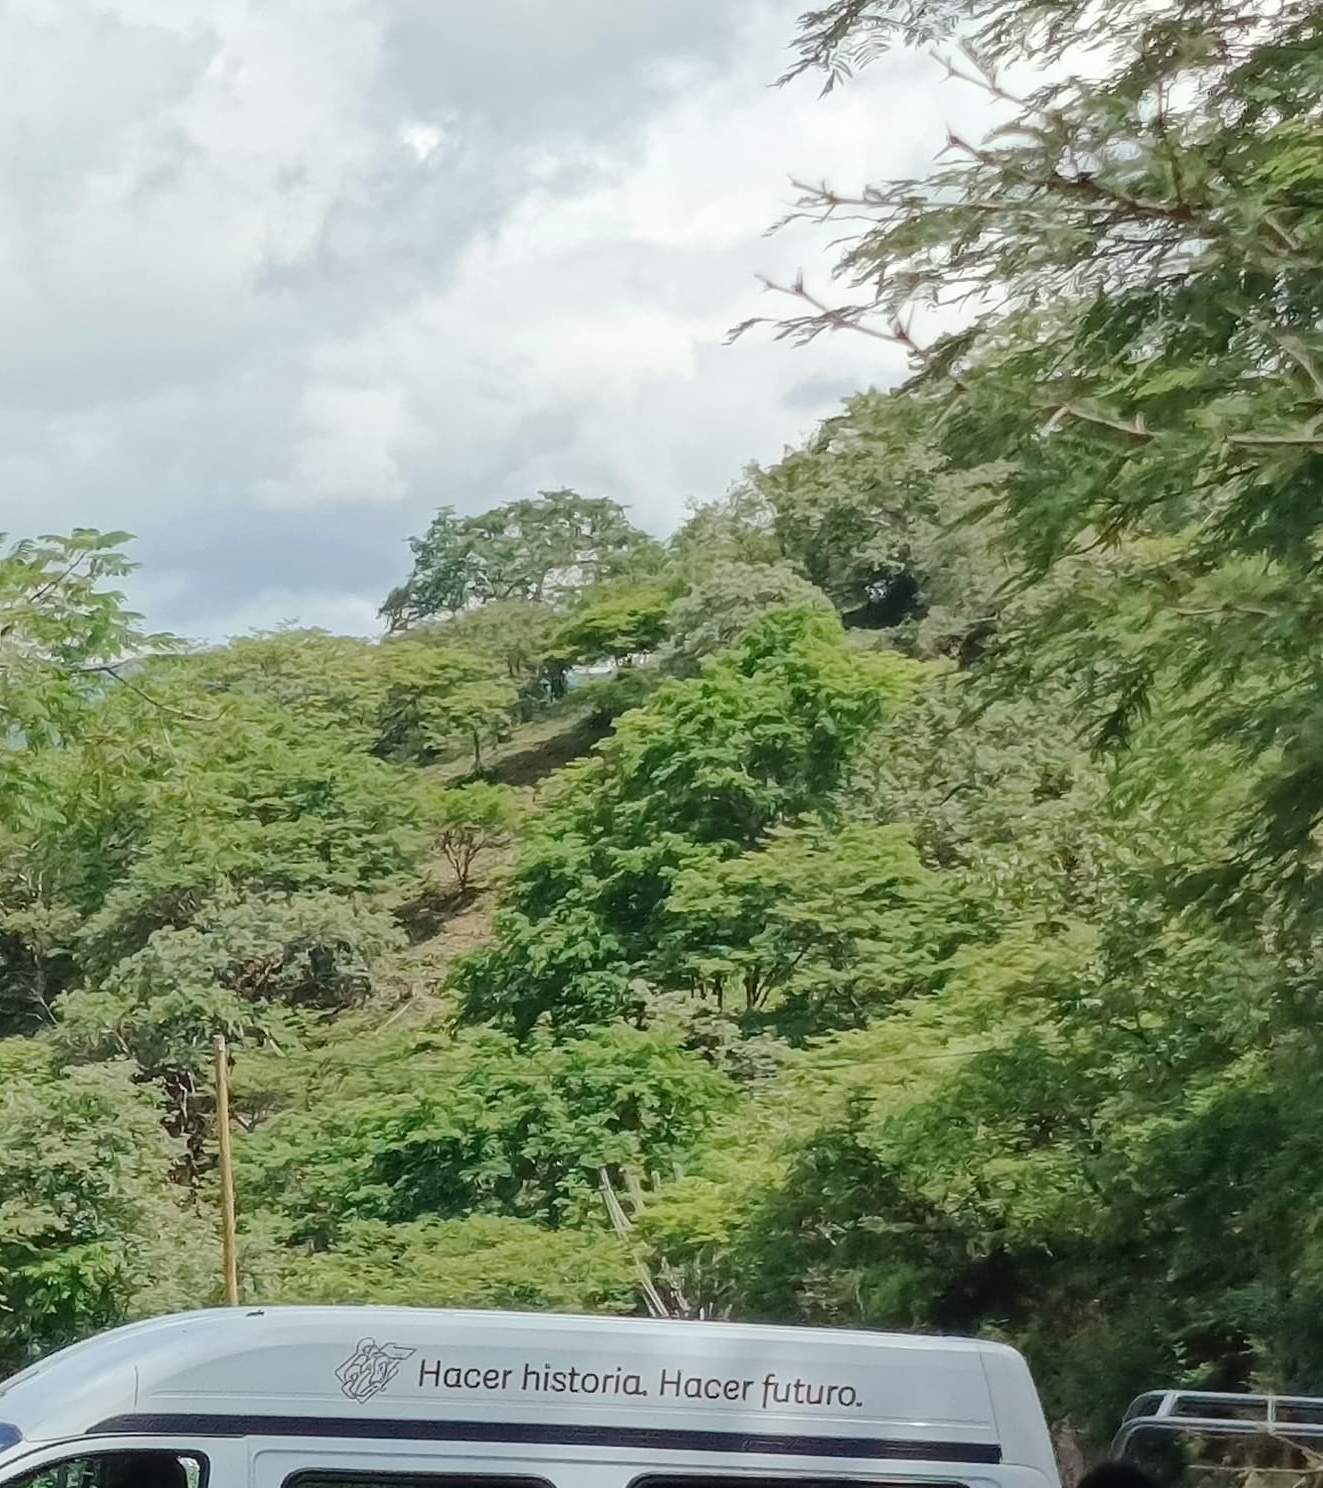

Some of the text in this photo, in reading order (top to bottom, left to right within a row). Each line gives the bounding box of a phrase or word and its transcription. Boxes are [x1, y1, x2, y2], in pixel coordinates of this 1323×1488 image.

[418, 1359, 863, 1408] Hacer historia. Hacer futuro.
